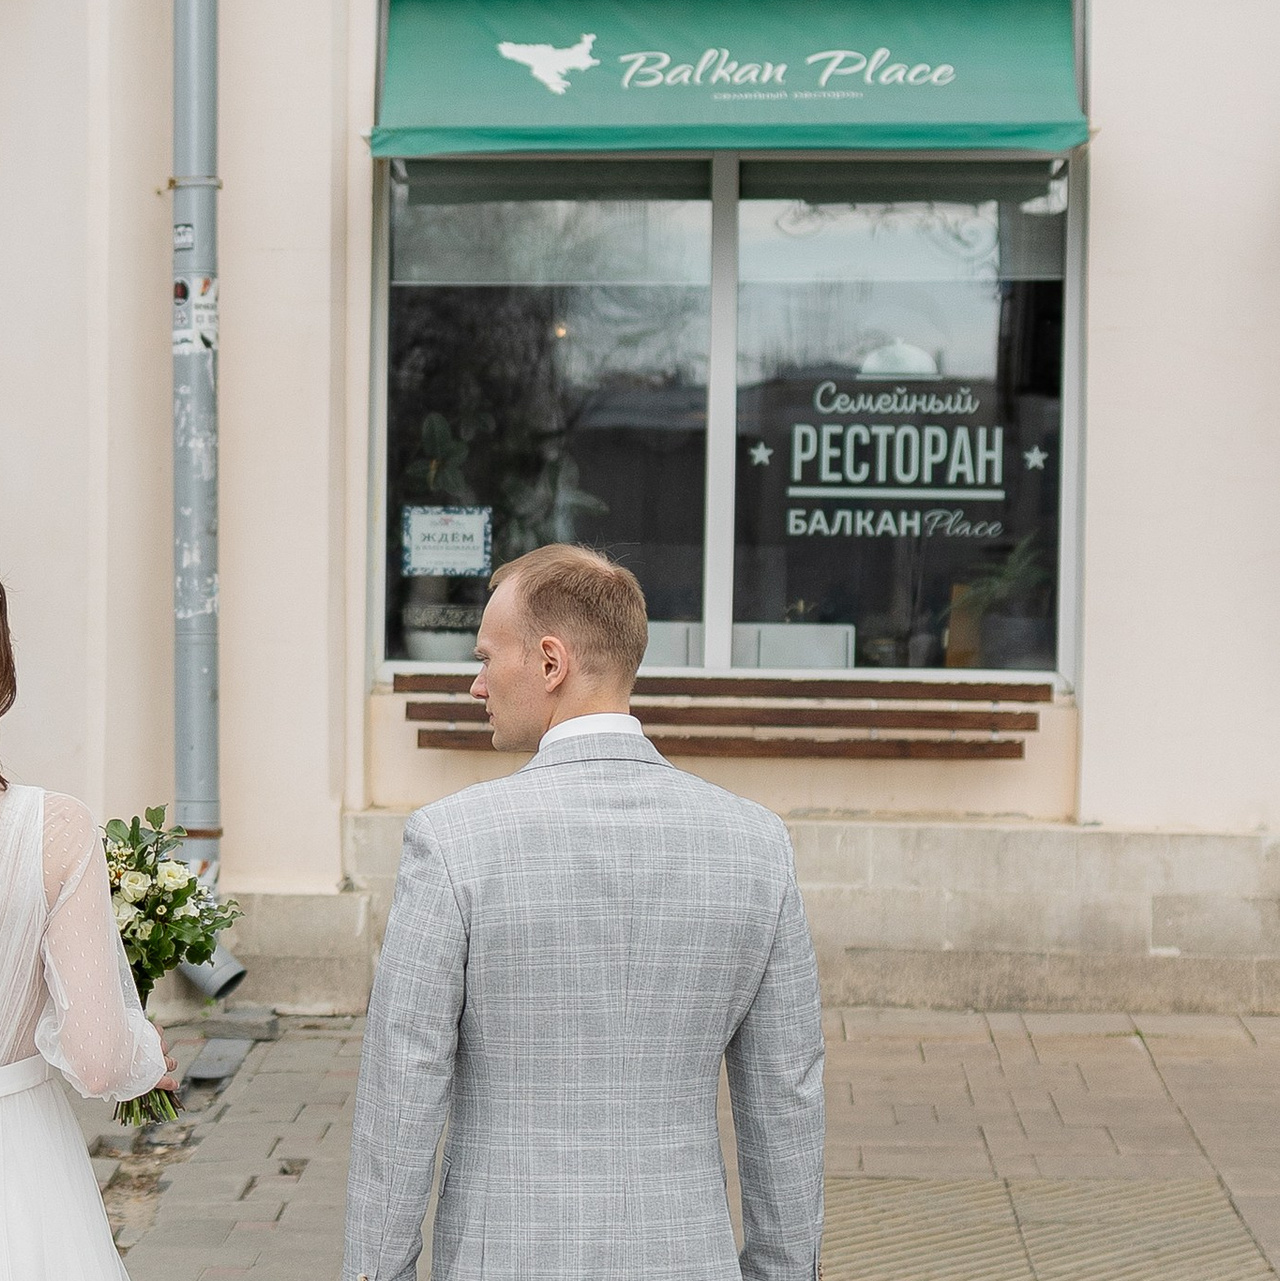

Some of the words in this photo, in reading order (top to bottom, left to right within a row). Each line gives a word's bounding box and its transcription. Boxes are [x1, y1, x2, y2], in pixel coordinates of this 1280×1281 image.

[618, 47, 789, 89] Balkan
[805, 46, 958, 88] Place
[813, 380, 981, 415] Семейный
[792, 423, 1005, 485] РЕСТОРАН
